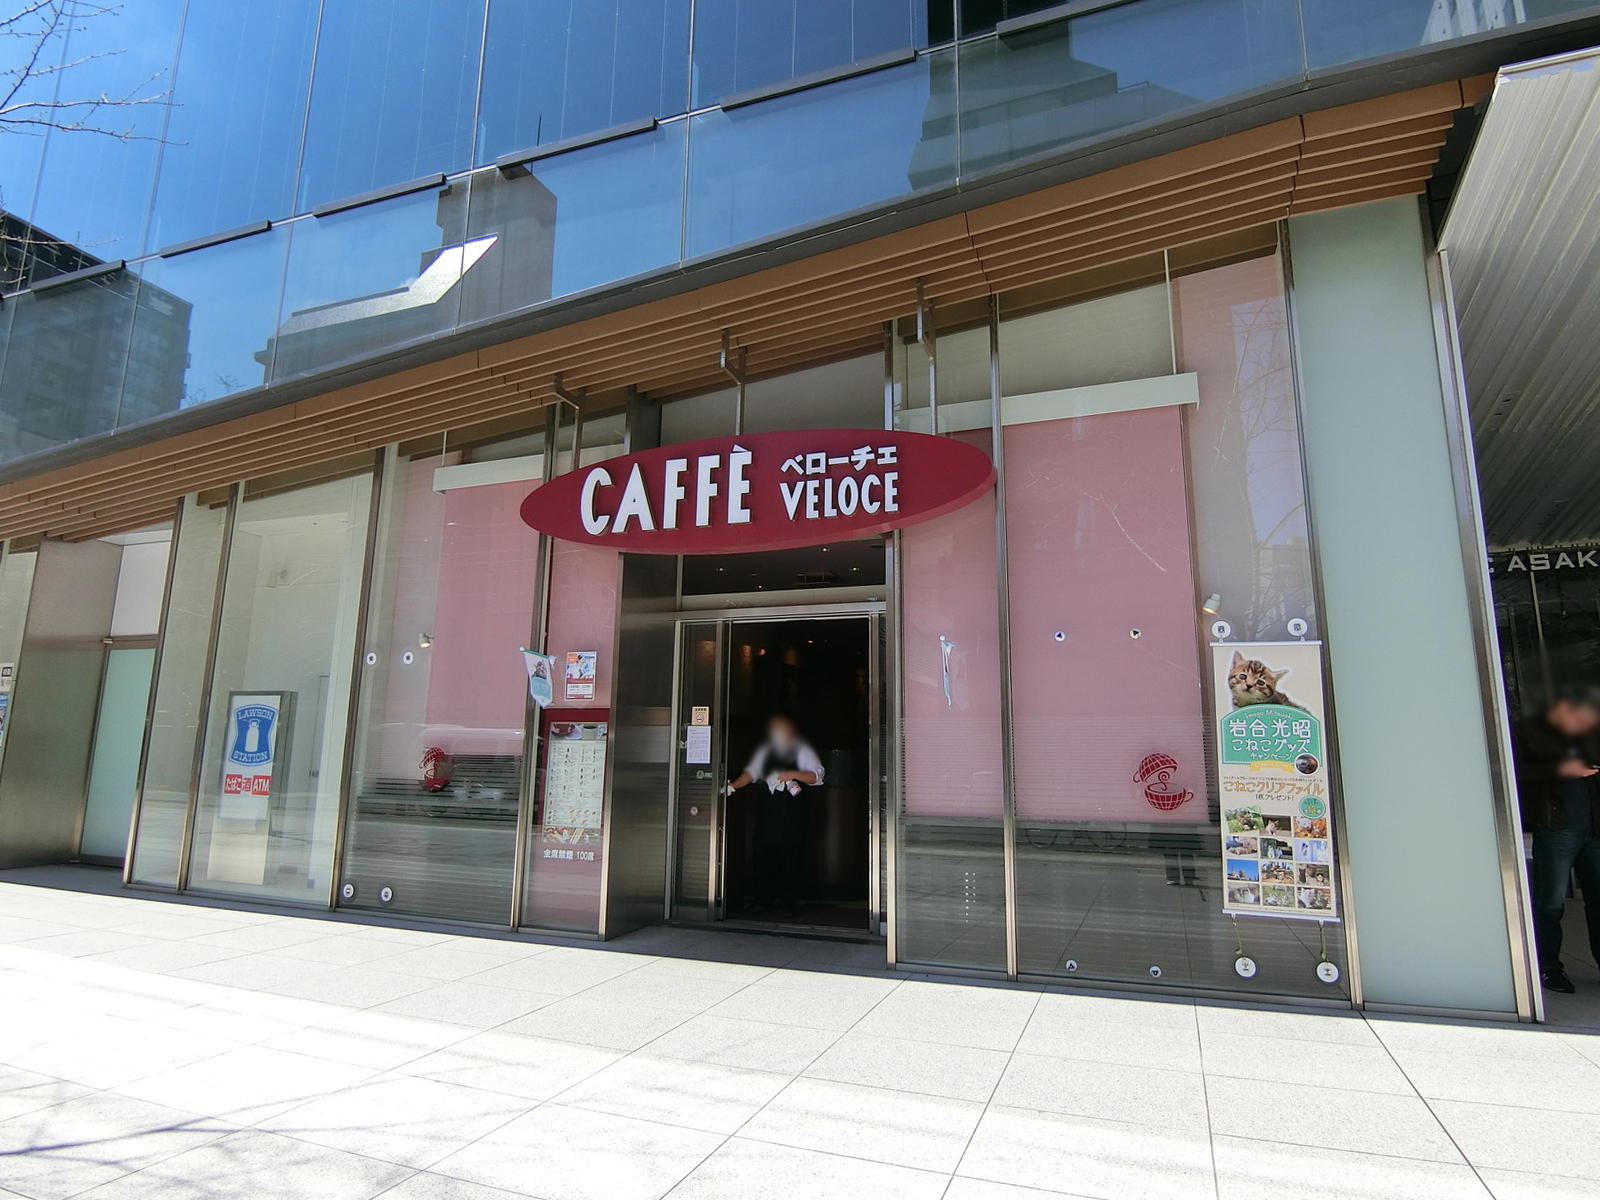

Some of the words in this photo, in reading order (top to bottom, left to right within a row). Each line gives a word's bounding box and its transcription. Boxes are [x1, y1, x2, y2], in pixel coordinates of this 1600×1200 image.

[780, 445, 898, 475] ベローチェ
[580, 444, 753, 536] CAFFÈ
[779, 471, 899, 521] VELOCE
[238, 708, 274, 721] LAWSON
[1231, 738, 1310, 753] こねこグッズ
[232, 750, 268, 762] STATION
[1250, 752, 1292, 760] キャンペーン
[252, 778, 270, 792] ATM
[1223, 780, 1324, 795] こねこクリアファイル
